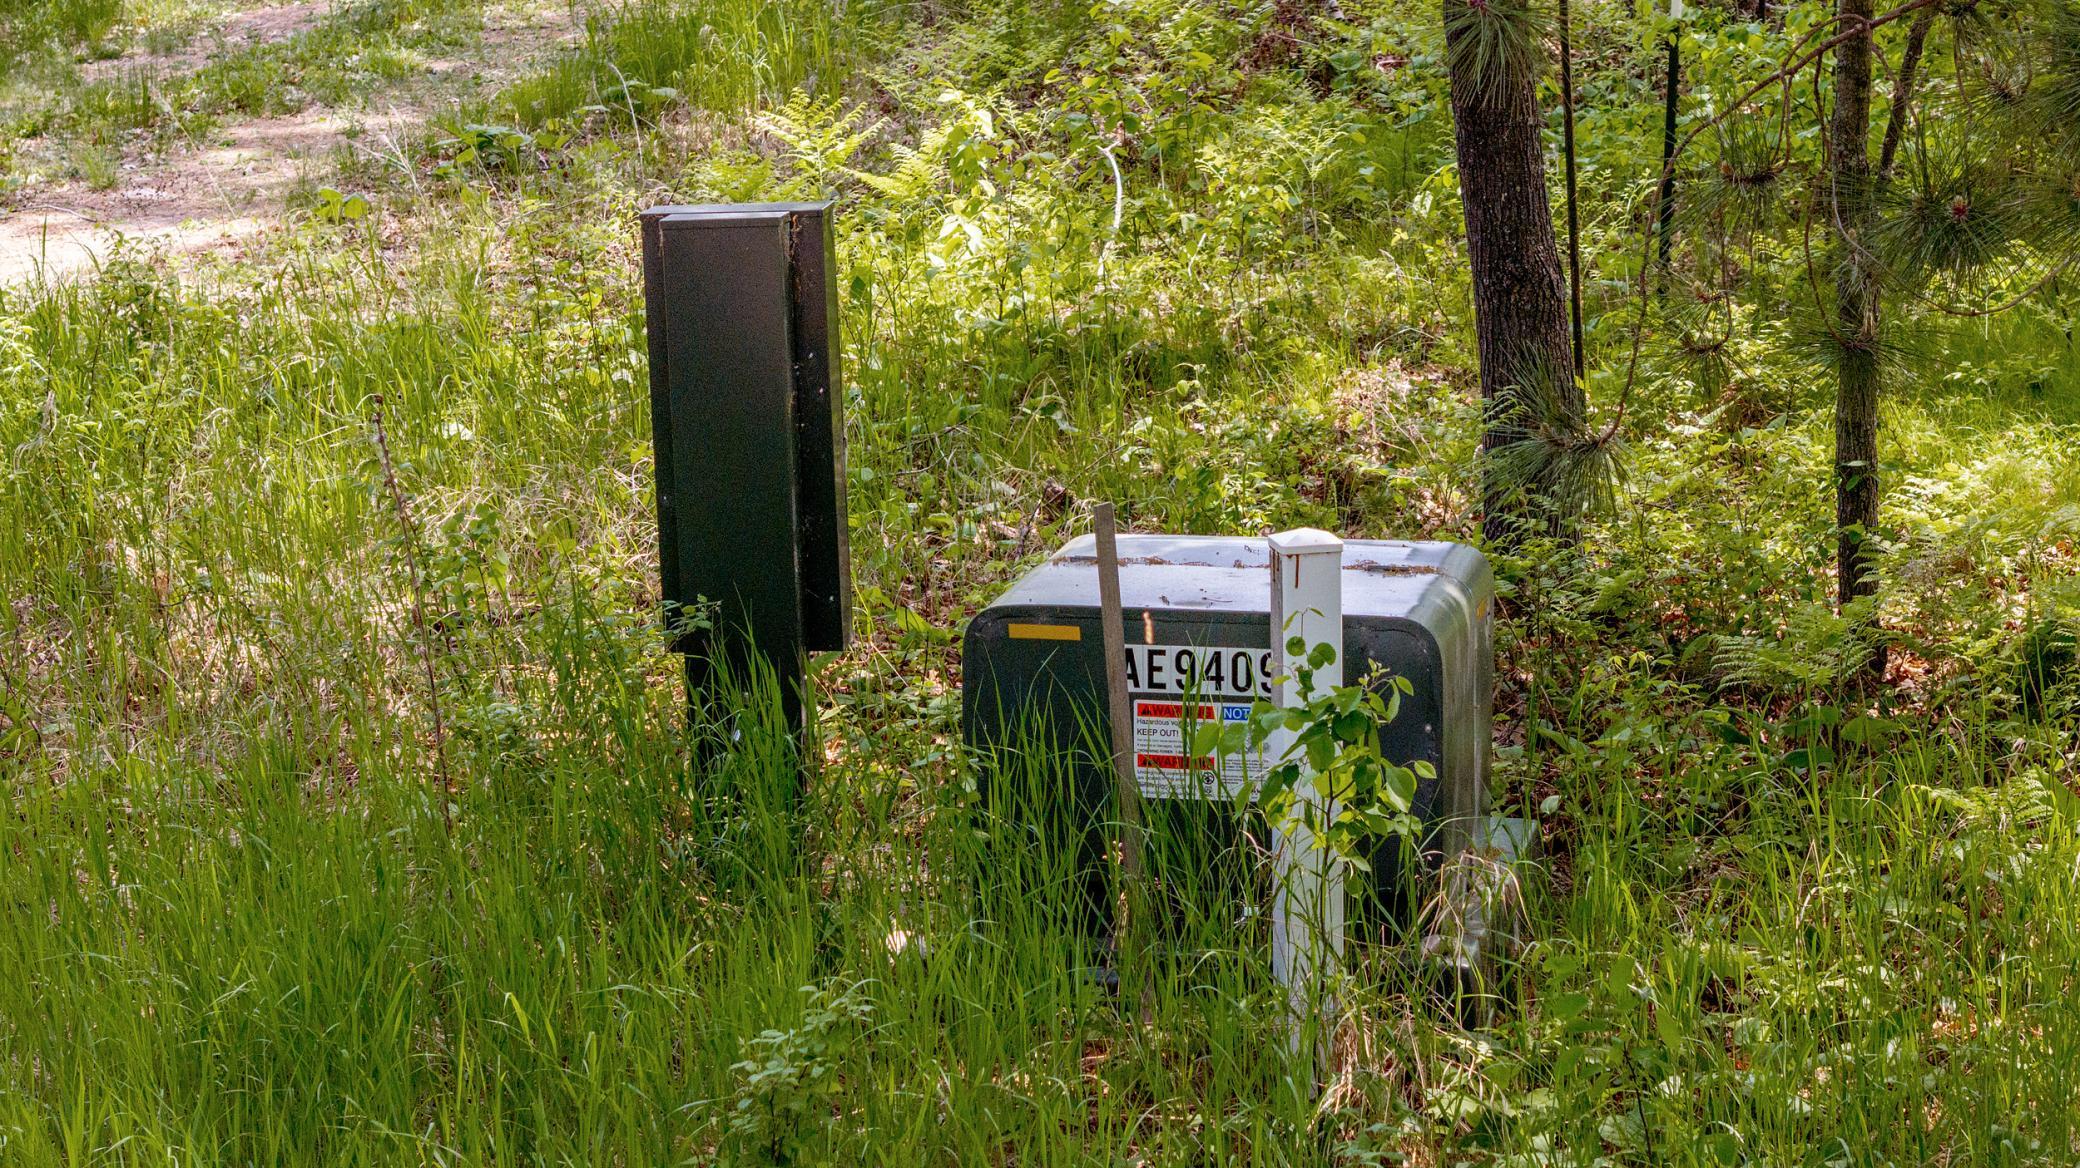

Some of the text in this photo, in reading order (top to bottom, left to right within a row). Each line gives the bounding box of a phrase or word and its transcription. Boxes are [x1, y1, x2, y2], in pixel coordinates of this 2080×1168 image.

[1223, 707, 1250, 720] NOT
[1136, 728, 1179, 738] KEEP OUT!
